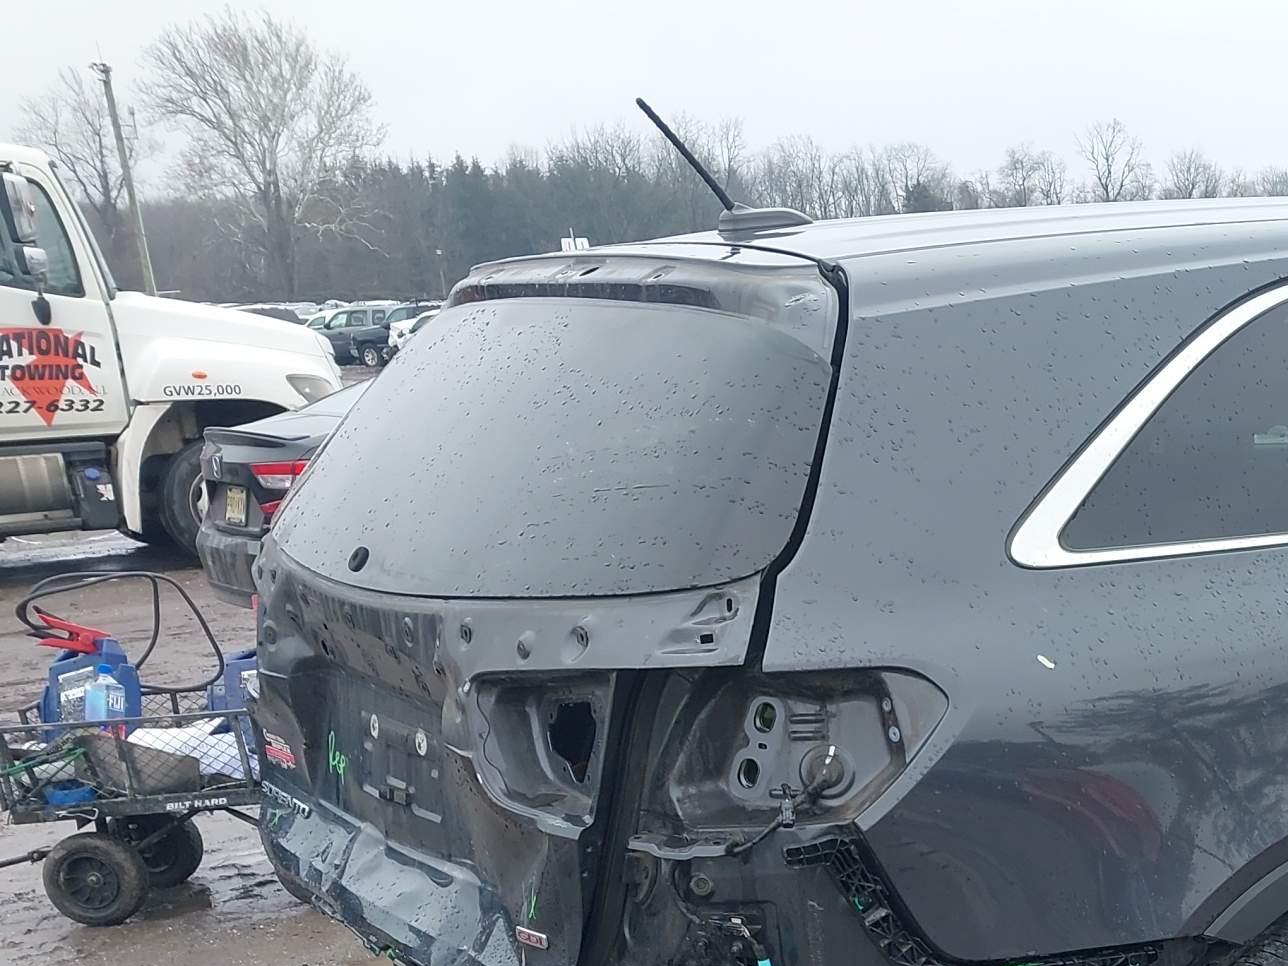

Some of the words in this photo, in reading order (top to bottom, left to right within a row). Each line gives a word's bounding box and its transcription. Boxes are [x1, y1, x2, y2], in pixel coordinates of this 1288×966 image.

[0, 330, 101, 368] ATIONAL
[0, 364, 84, 381] TOWING
[163, 384, 241, 397] GVW25,000
[0, 399, 104, 414] 27-6332
[166, 800, 191, 811] BILT
[194, 797, 227, 808] HARD
[261, 780, 310, 817] SORENTO
